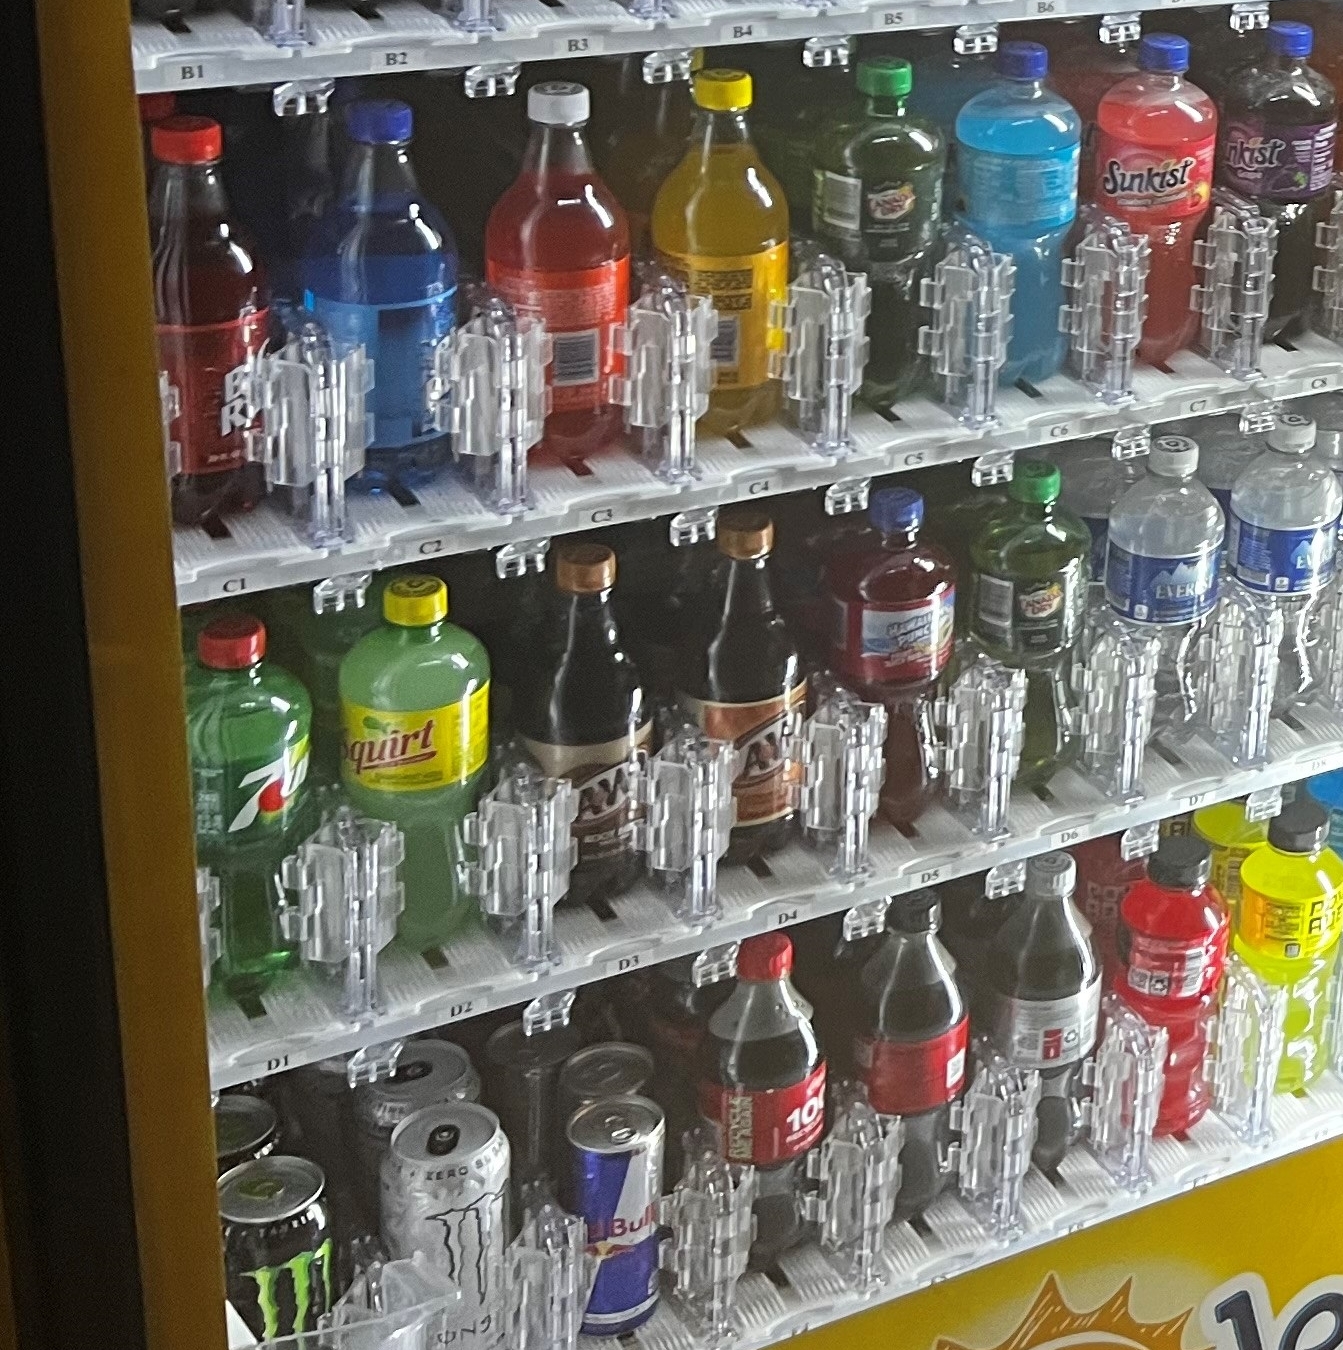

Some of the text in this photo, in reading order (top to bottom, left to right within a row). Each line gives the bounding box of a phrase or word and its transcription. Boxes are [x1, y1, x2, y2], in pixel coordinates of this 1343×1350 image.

[1037, 1, 1055, 13] B6
[884, 12, 903, 24] B5
[733, 25, 752, 38] B4
[568, 39, 588, 52] B3
[385, 52, 408, 66] B2
[181, 65, 203, 80] B1
[1102, 158, 1193, 196] Sunkist
[1189, 399, 1207, 412] C7
[1050, 424, 1069, 437] C6
[904, 452, 924, 465] C5
[749, 481, 770, 494] C4
[592, 510, 613, 524] C3
[419, 539, 442, 555] C2
[223, 578, 246, 593] C1
[343, 719, 435, 775] quirt
[1061, 831, 1078, 843] D6
[921, 870, 939, 883] D5
[778, 910, 798, 924] D4
[618, 956, 639, 971] D3
[450, 1002, 473, 1017] D2
[267, 1055, 290, 1071] D1
